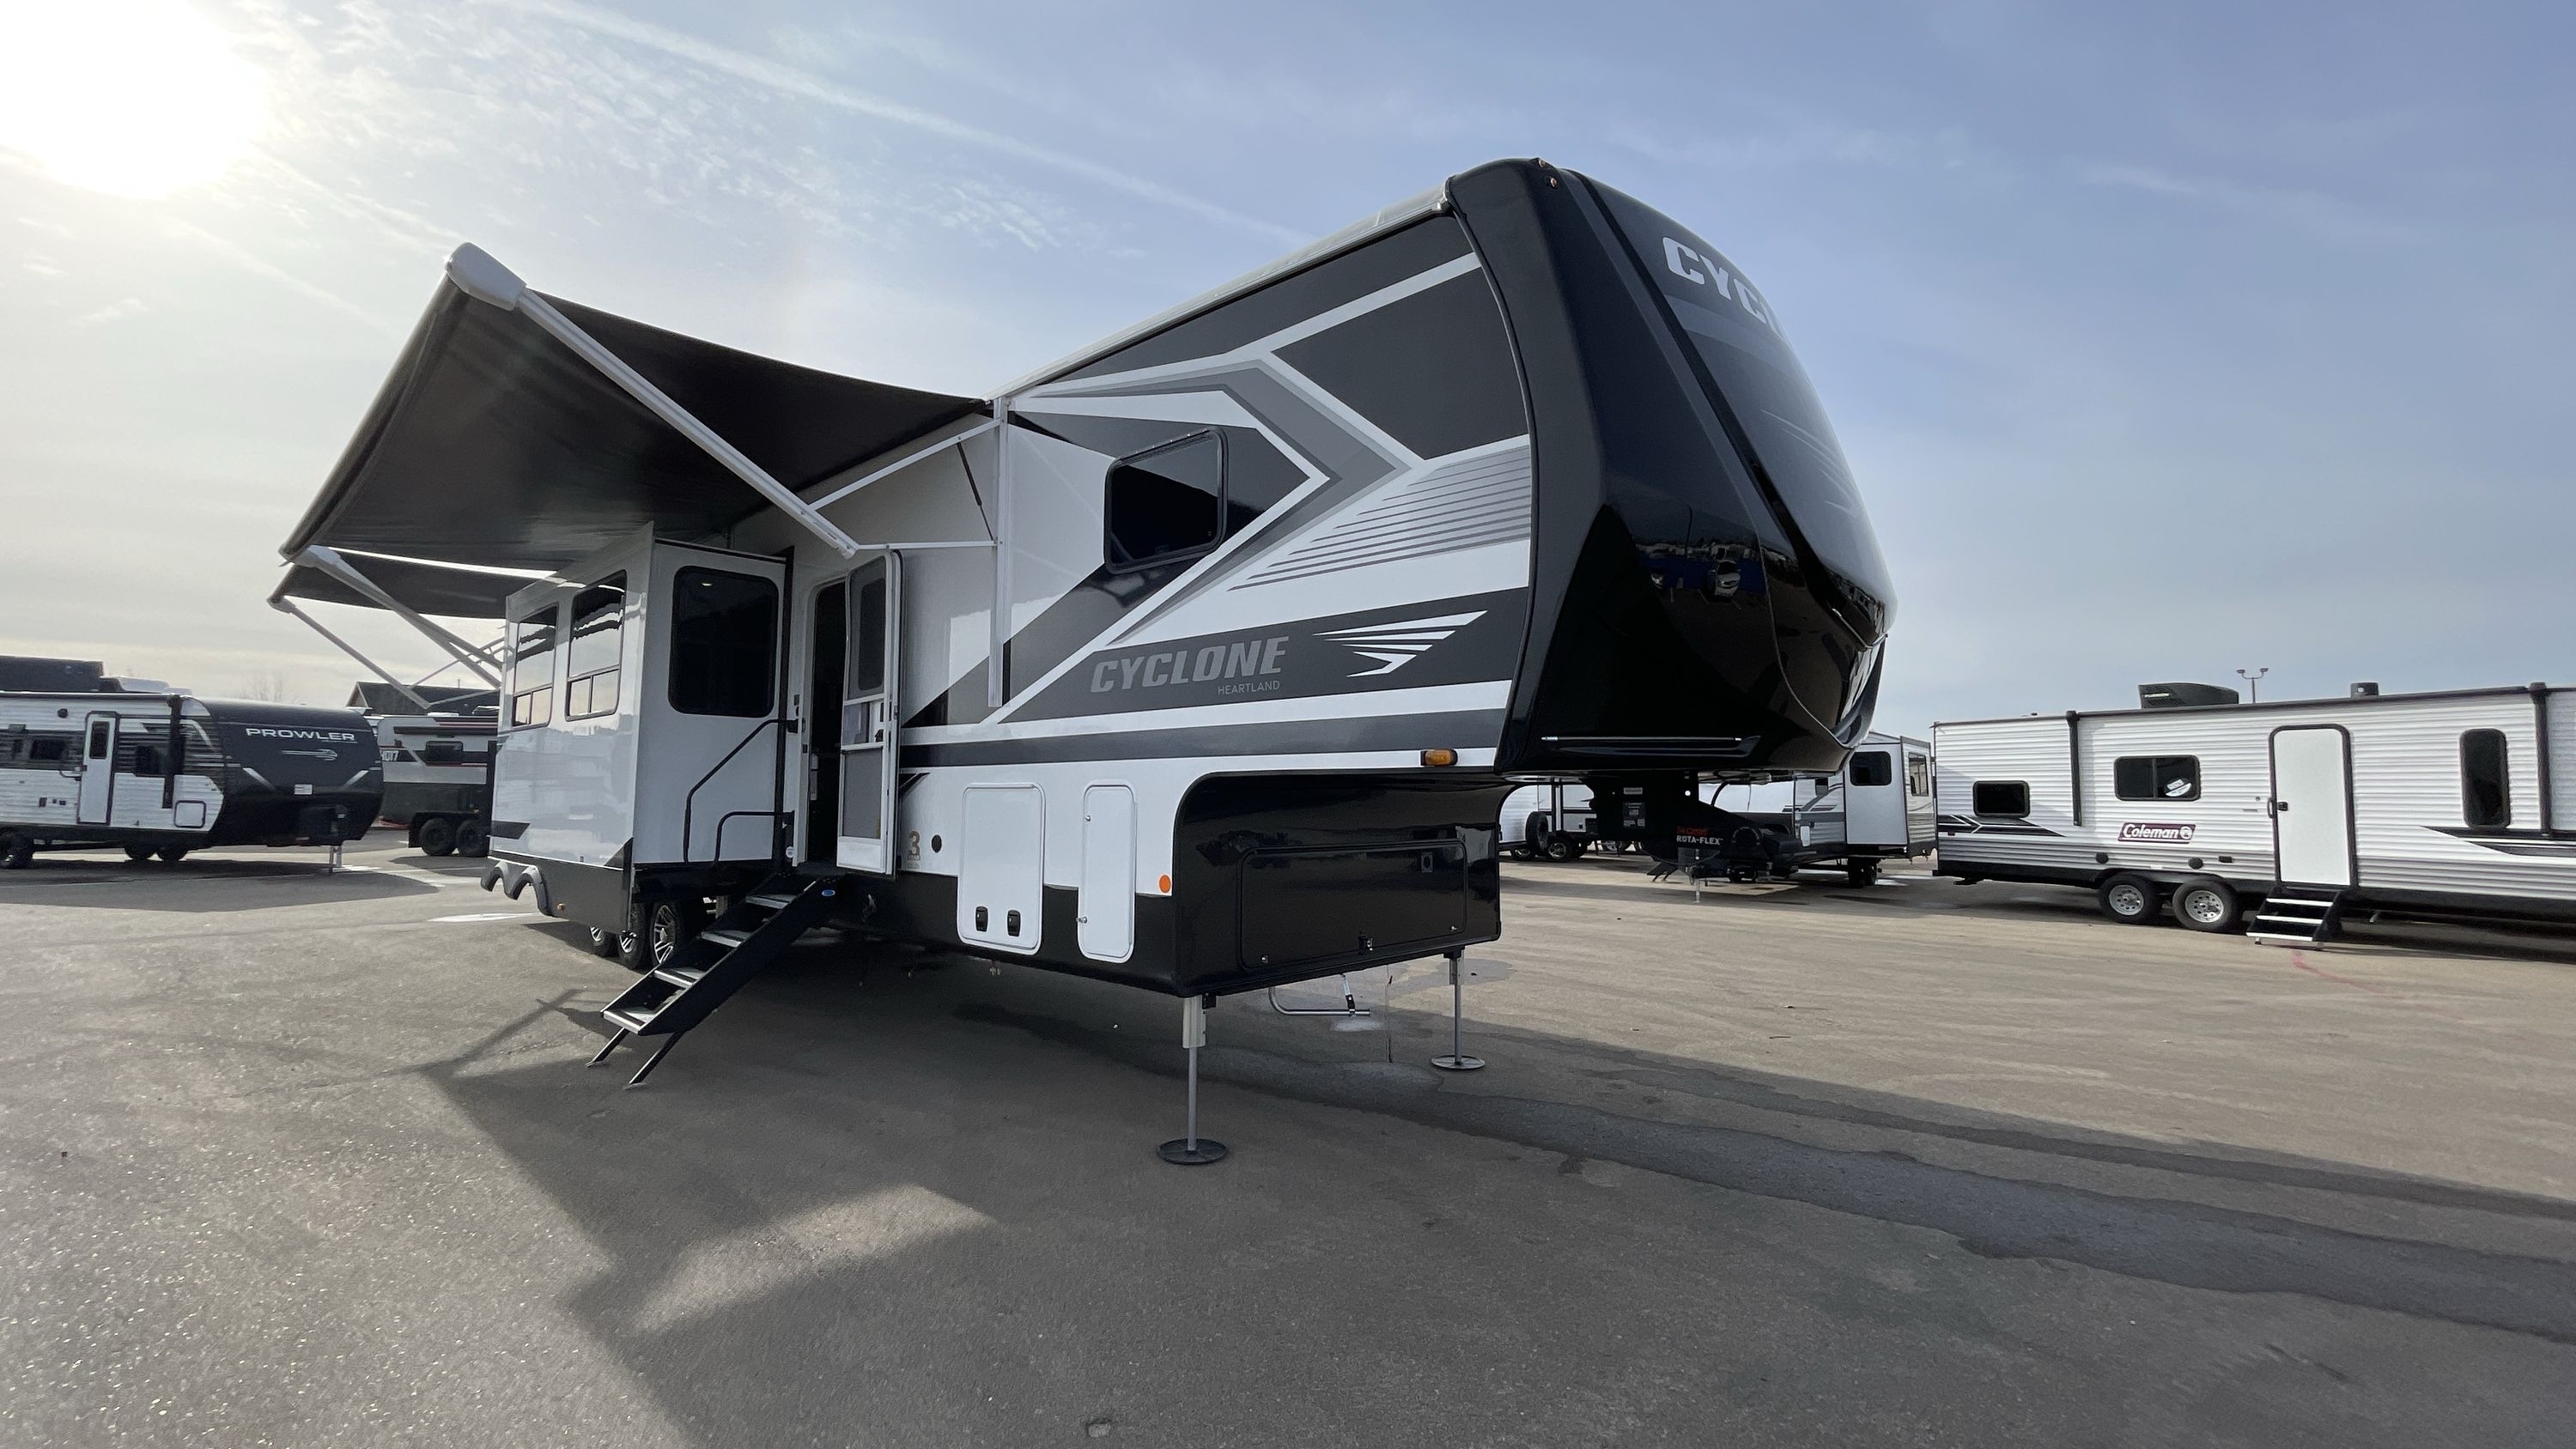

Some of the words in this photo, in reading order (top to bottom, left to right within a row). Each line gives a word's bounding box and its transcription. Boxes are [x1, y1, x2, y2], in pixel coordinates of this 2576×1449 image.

[1090, 635, 1289, 693] CYCLONE
[1218, 680, 1280, 695] HEARTLAND
[245, 727, 356, 741] PROWLER
[2123, 823, 2179, 839] Coleman
[908, 830, 920, 856] 3
